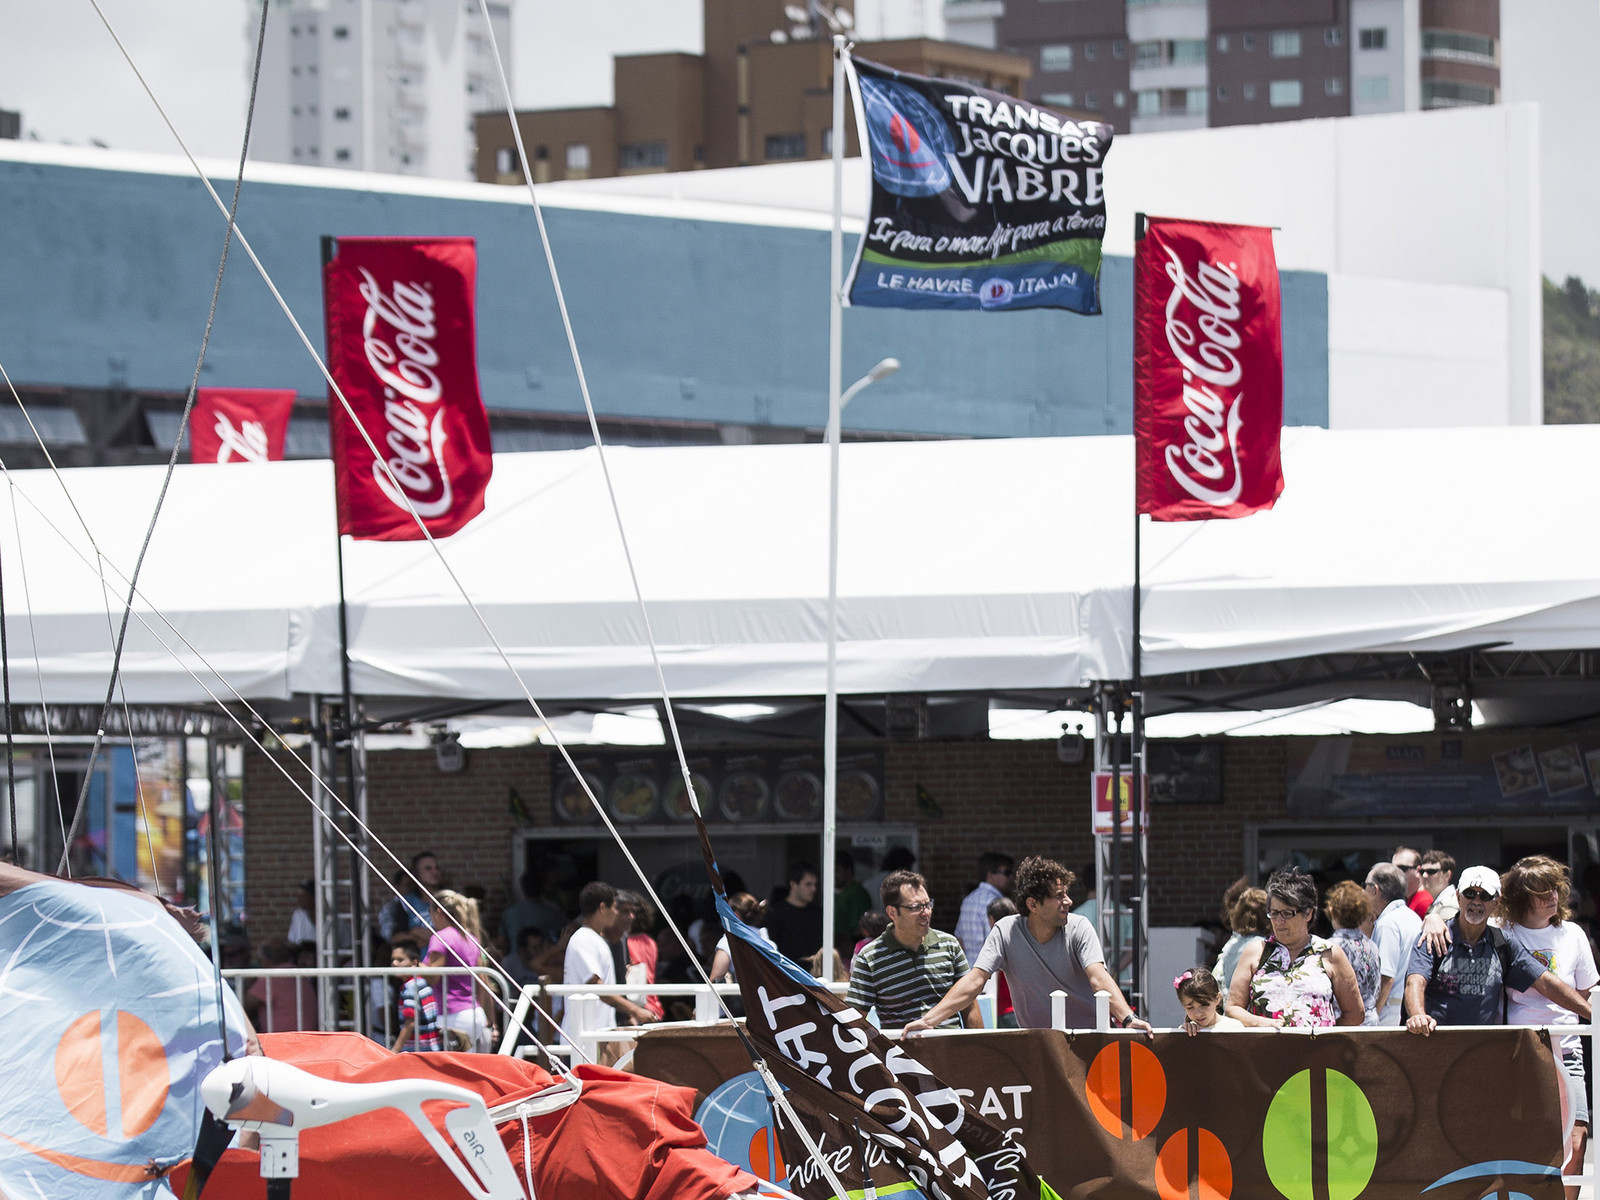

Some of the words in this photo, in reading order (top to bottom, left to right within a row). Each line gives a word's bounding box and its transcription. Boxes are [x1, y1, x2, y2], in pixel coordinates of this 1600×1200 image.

[944, 94, 1101, 138] TRANSAT
[943, 152, 1103, 206] VABRE
[890, 229, 931, 252] para
[1011, 223, 1050, 251] para
[1052, 216, 1063, 232] a
[877, 272, 903, 290] LE
[906, 276, 973, 293] HAVRE
